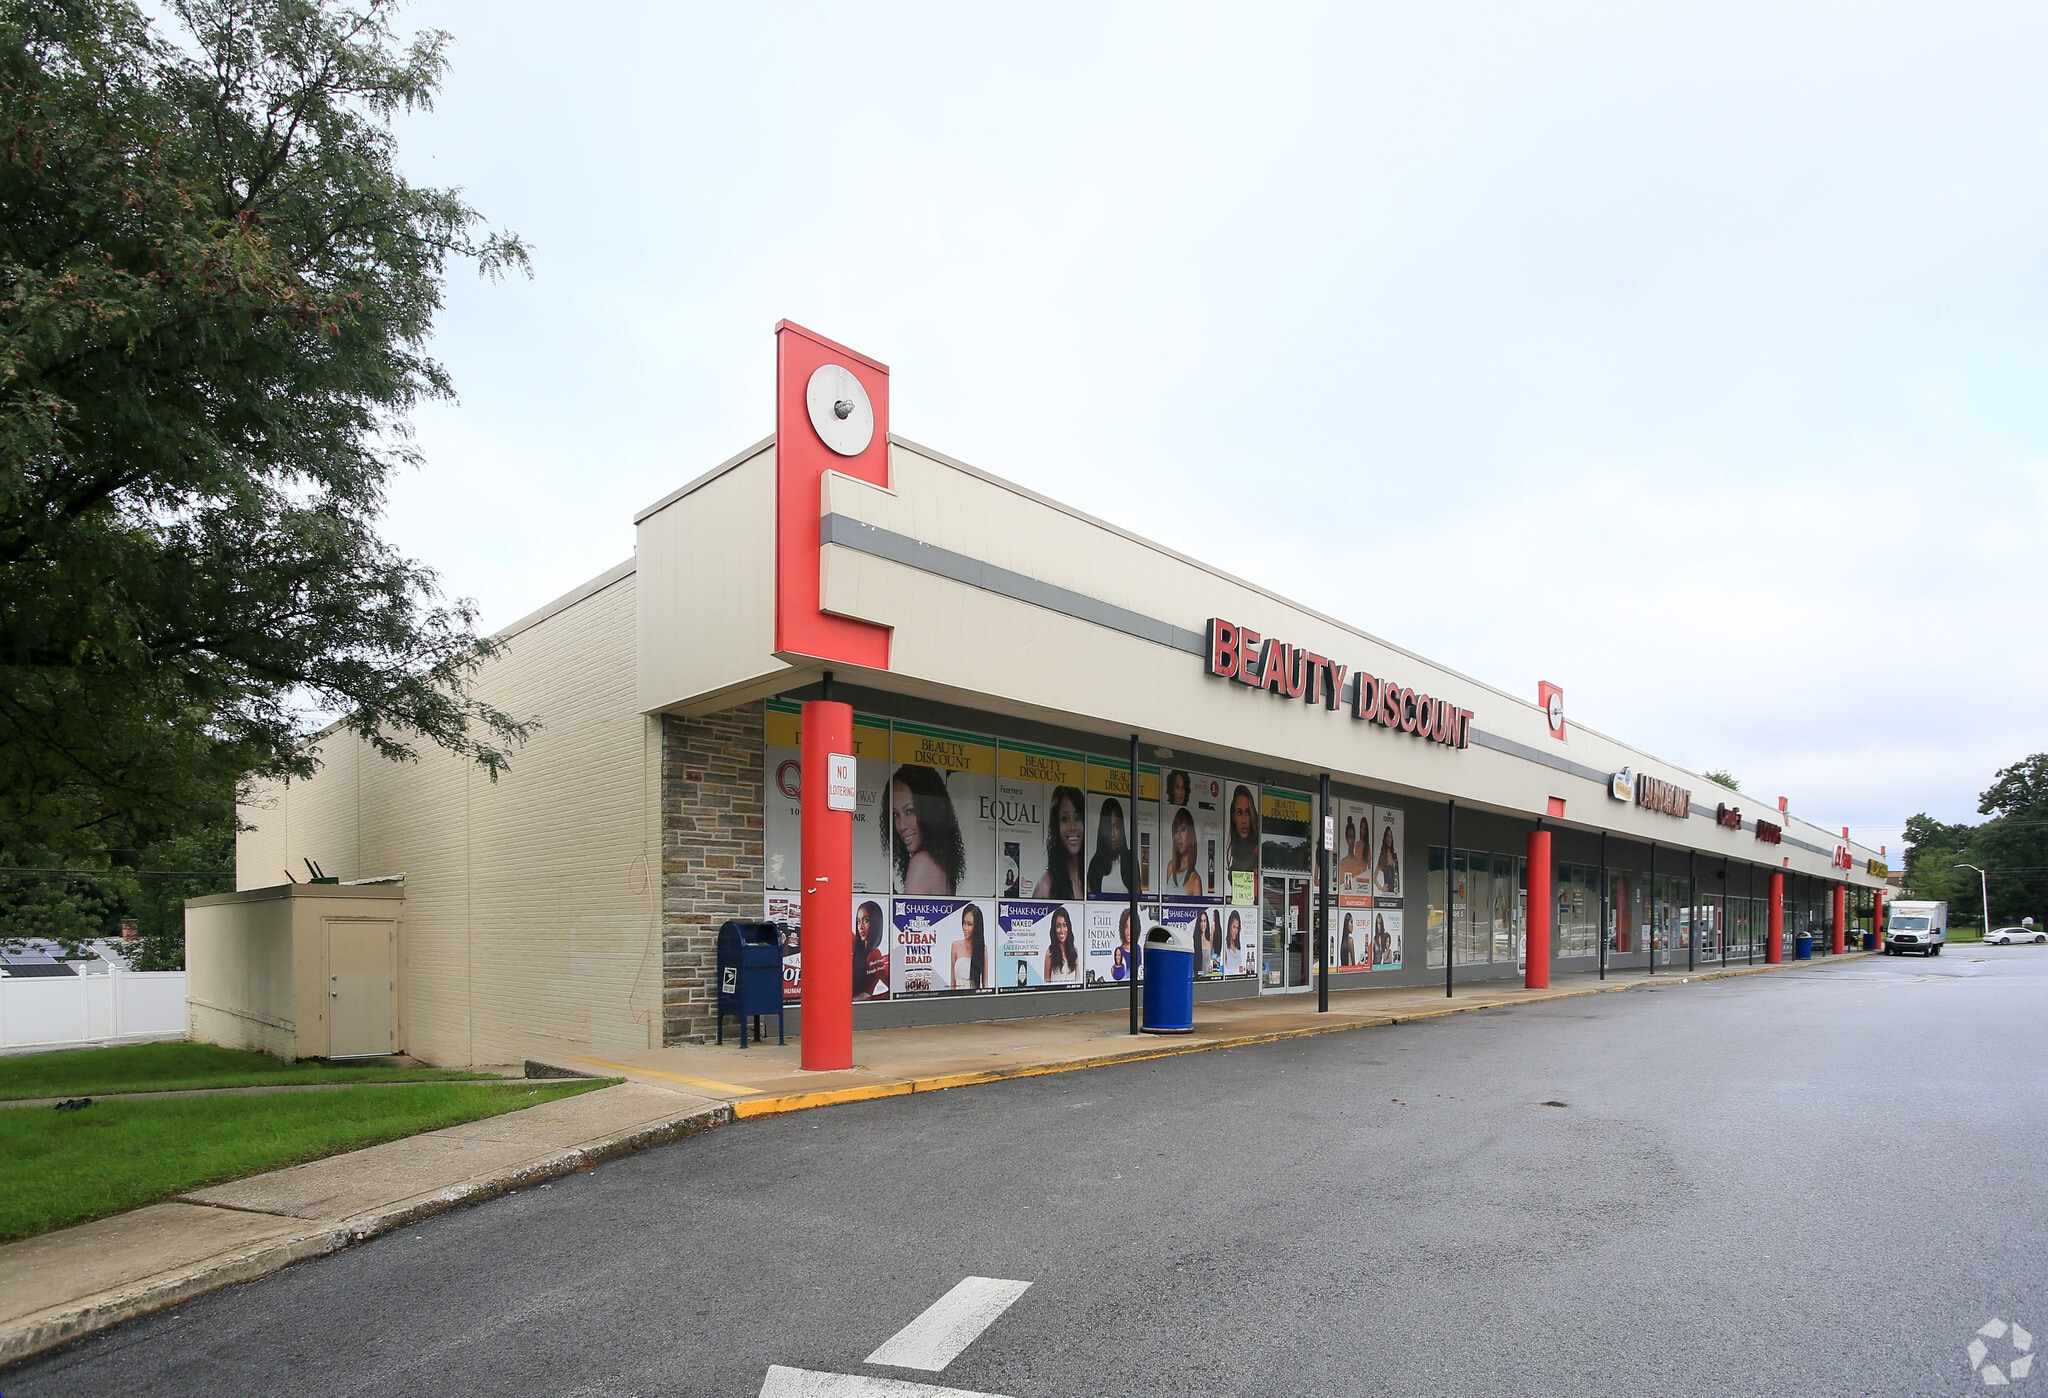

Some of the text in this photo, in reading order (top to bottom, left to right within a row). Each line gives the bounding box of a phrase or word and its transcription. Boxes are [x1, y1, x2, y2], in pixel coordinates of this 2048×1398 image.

[1206, 617, 1475, 749] BEAUTY DISCOUNT
[921, 739, 965, 756] BEAUTY
[914, 751, 971, 769] DISCOUNT
[1025, 755, 1062, 771] BEAUTY
[837, 765, 848, 779] NO
[1019, 766, 1067, 784] DISCOUNT
[830, 785, 855, 797] LOITERING
[1104, 780, 1145, 795] DISCOUT
[979, 795, 1040, 826] EQUAL
[1274, 800, 1297, 809] BEAUTY
[1271, 808, 1299, 820] DISCOUNT
[906, 904, 953, 914] SHAKE-N-GO
[1009, 906, 1048, 916] SHAKE-N-GO
[1011, 919, 1033, 927] NAKED
[897, 932, 937, 944] CUBAN
[1088, 929, 1116, 939] INDIAN
[905, 945, 932, 955] TWIST
[1091, 939, 1111, 949] REMY
[905, 956, 932, 964] BRAID
